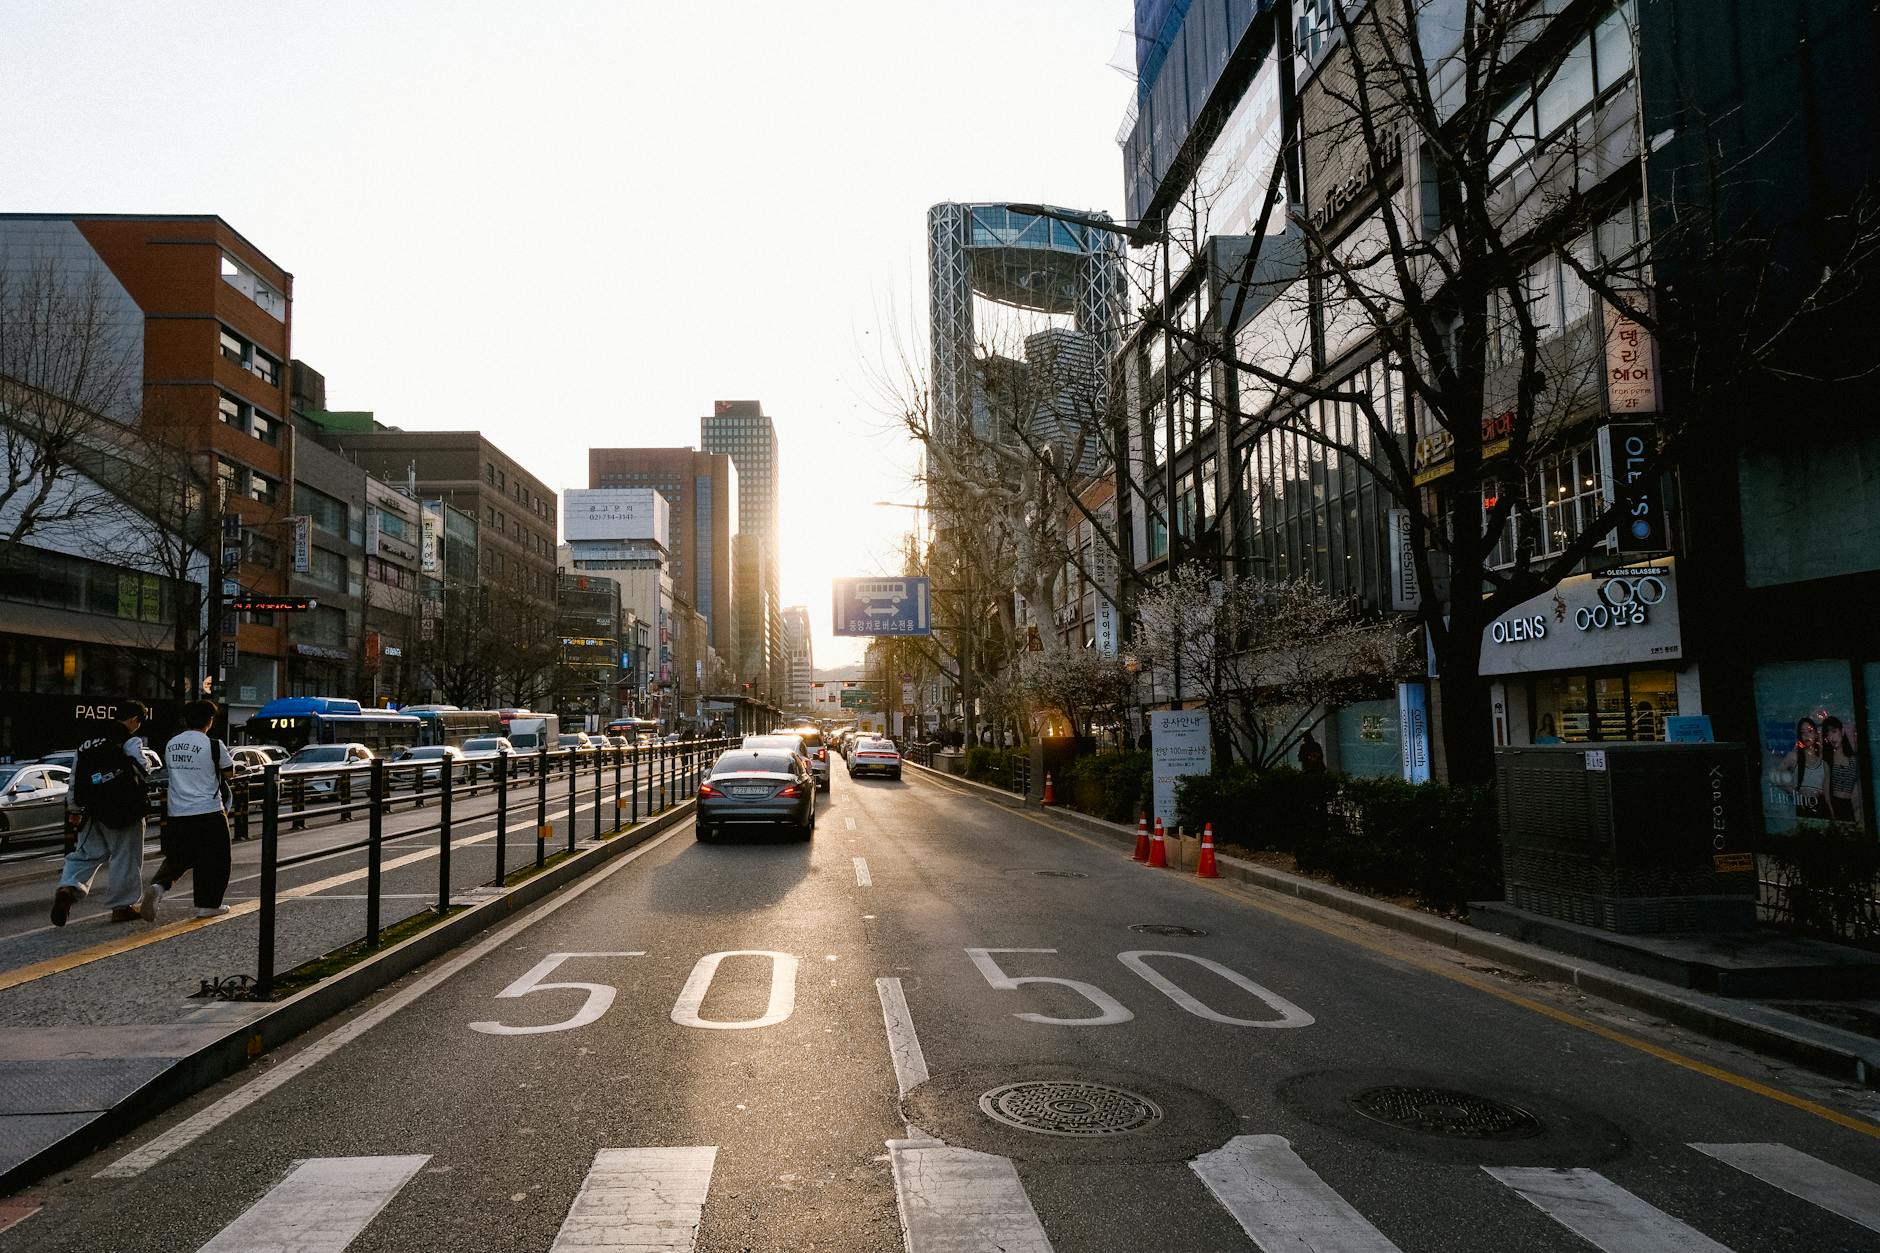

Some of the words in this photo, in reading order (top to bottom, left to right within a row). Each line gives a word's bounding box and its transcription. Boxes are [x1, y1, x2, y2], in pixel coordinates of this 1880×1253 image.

[1613, 368, 1648, 381] 헤어
[1625, 398, 1639, 408] 2F
[1606, 567, 1630, 576] OLENS
[1630, 566, 1661, 575] GLASSES
[1610, 600, 1646, 627] 안경
[848, 618, 915, 632] 중앙차로버스전용
[1491, 614, 1547, 644] OLENS
[270, 717, 295, 729] 701
[1162, 717, 1201, 729] 공사안내
[1413, 709, 1427, 767] coffeesmith
[167, 743, 190, 753] YONG
[191, 744, 203, 755] IN
[172, 754, 194, 763] UNIV.
[469, 950, 799, 1035] 50
[964, 947, 1315, 1028] 50
